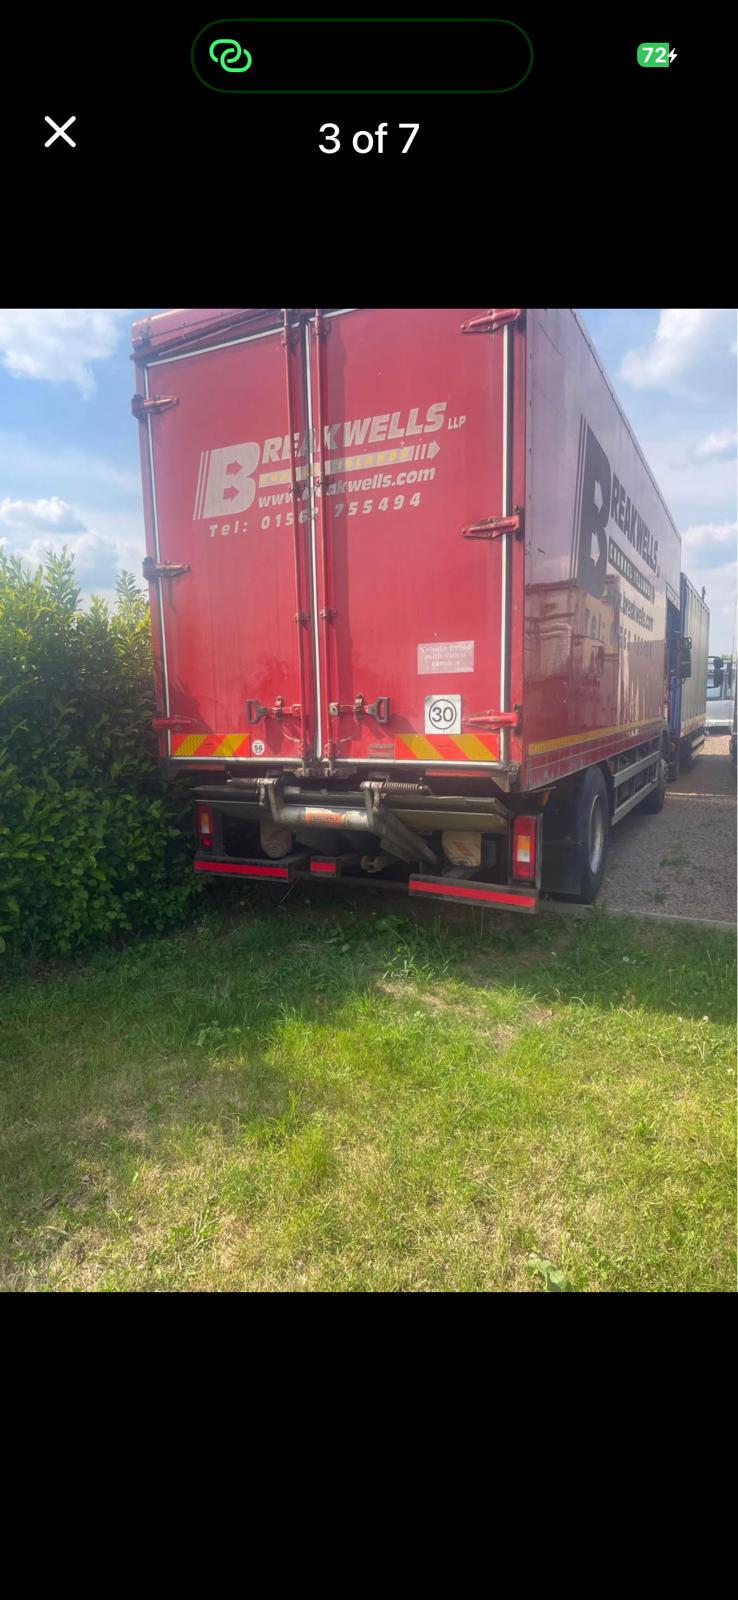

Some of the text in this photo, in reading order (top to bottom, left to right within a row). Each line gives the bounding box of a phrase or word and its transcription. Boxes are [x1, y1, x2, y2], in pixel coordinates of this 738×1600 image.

[202, 401, 467, 519] BREAKWELLS LLP
[209, 521, 248, 538] Tel:
[334, 492, 421, 518] 755494
[577, 424, 659, 598] BREAKWELLS
[432, 706, 454, 722] 30
